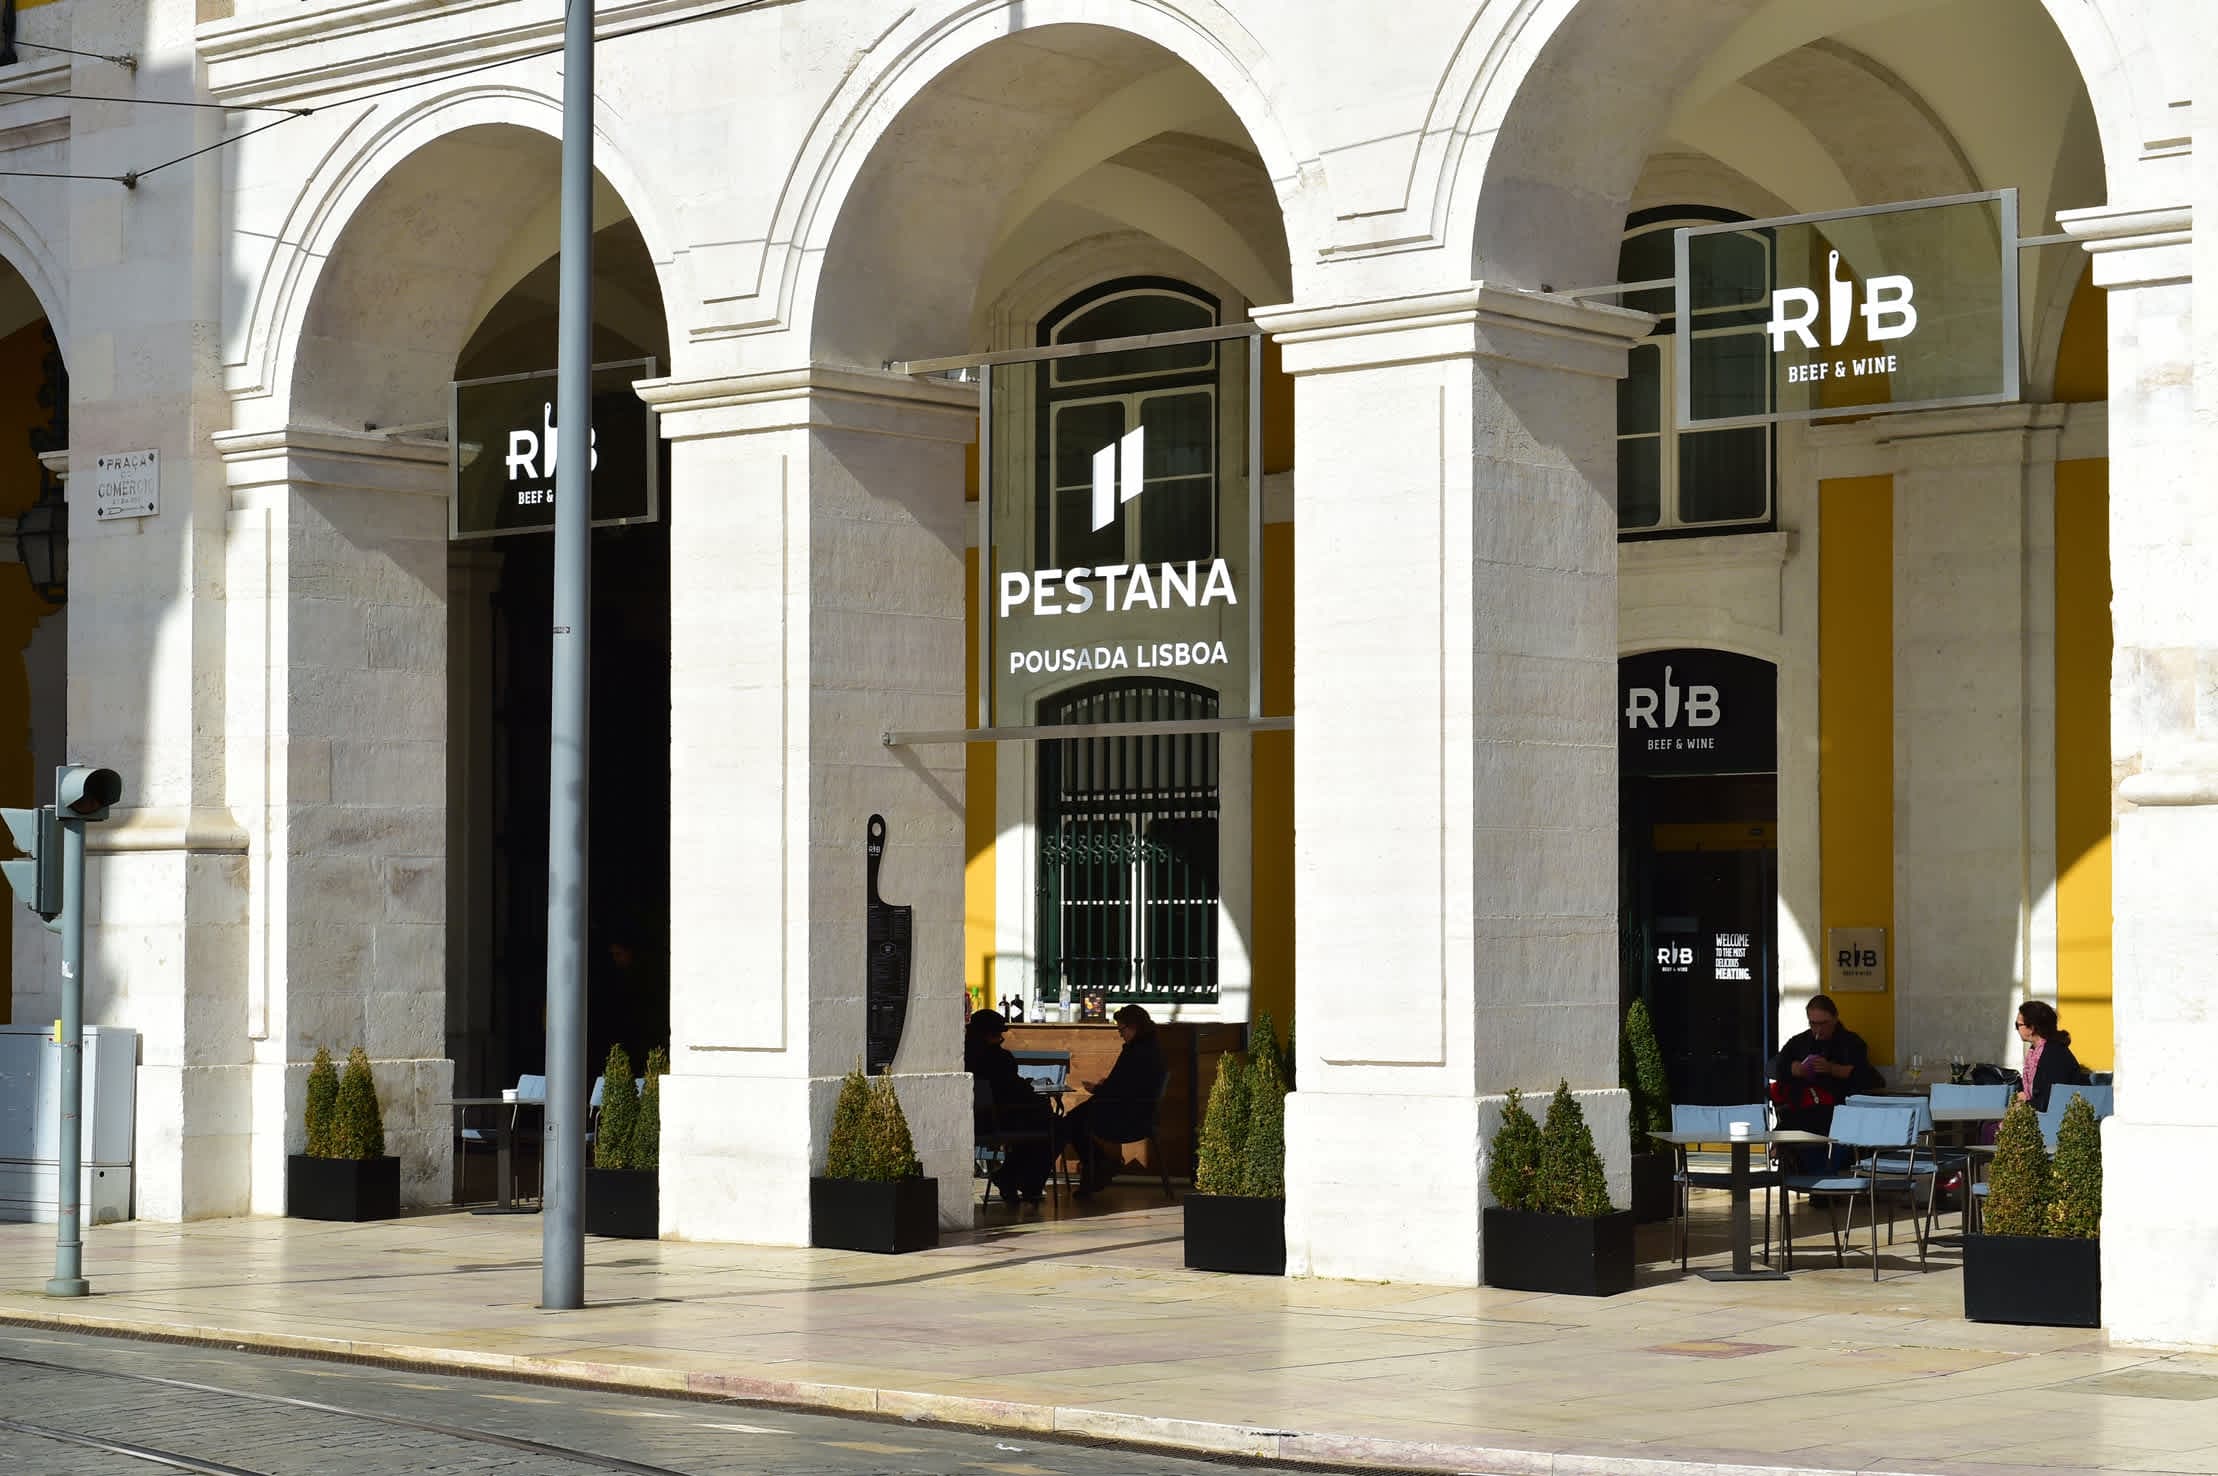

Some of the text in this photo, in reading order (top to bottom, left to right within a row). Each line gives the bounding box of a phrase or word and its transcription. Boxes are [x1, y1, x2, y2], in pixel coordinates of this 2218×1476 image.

[1788, 355, 1897, 384] BEEF & WINE
[505, 402, 598, 481] RI
[106, 455, 147, 471] PRAÇA
[518, 489, 554, 505] BEEF &
[1000, 558, 1237, 618] PESTANA
[1009, 640, 1229, 675] POUSADA LISBOA
[1647, 737, 1714, 751] BEEF & WINE
[1715, 933, 1750, 947] WELCOME
[1715, 947, 1722, 957] TO
[1723, 947, 1732, 957] THE
